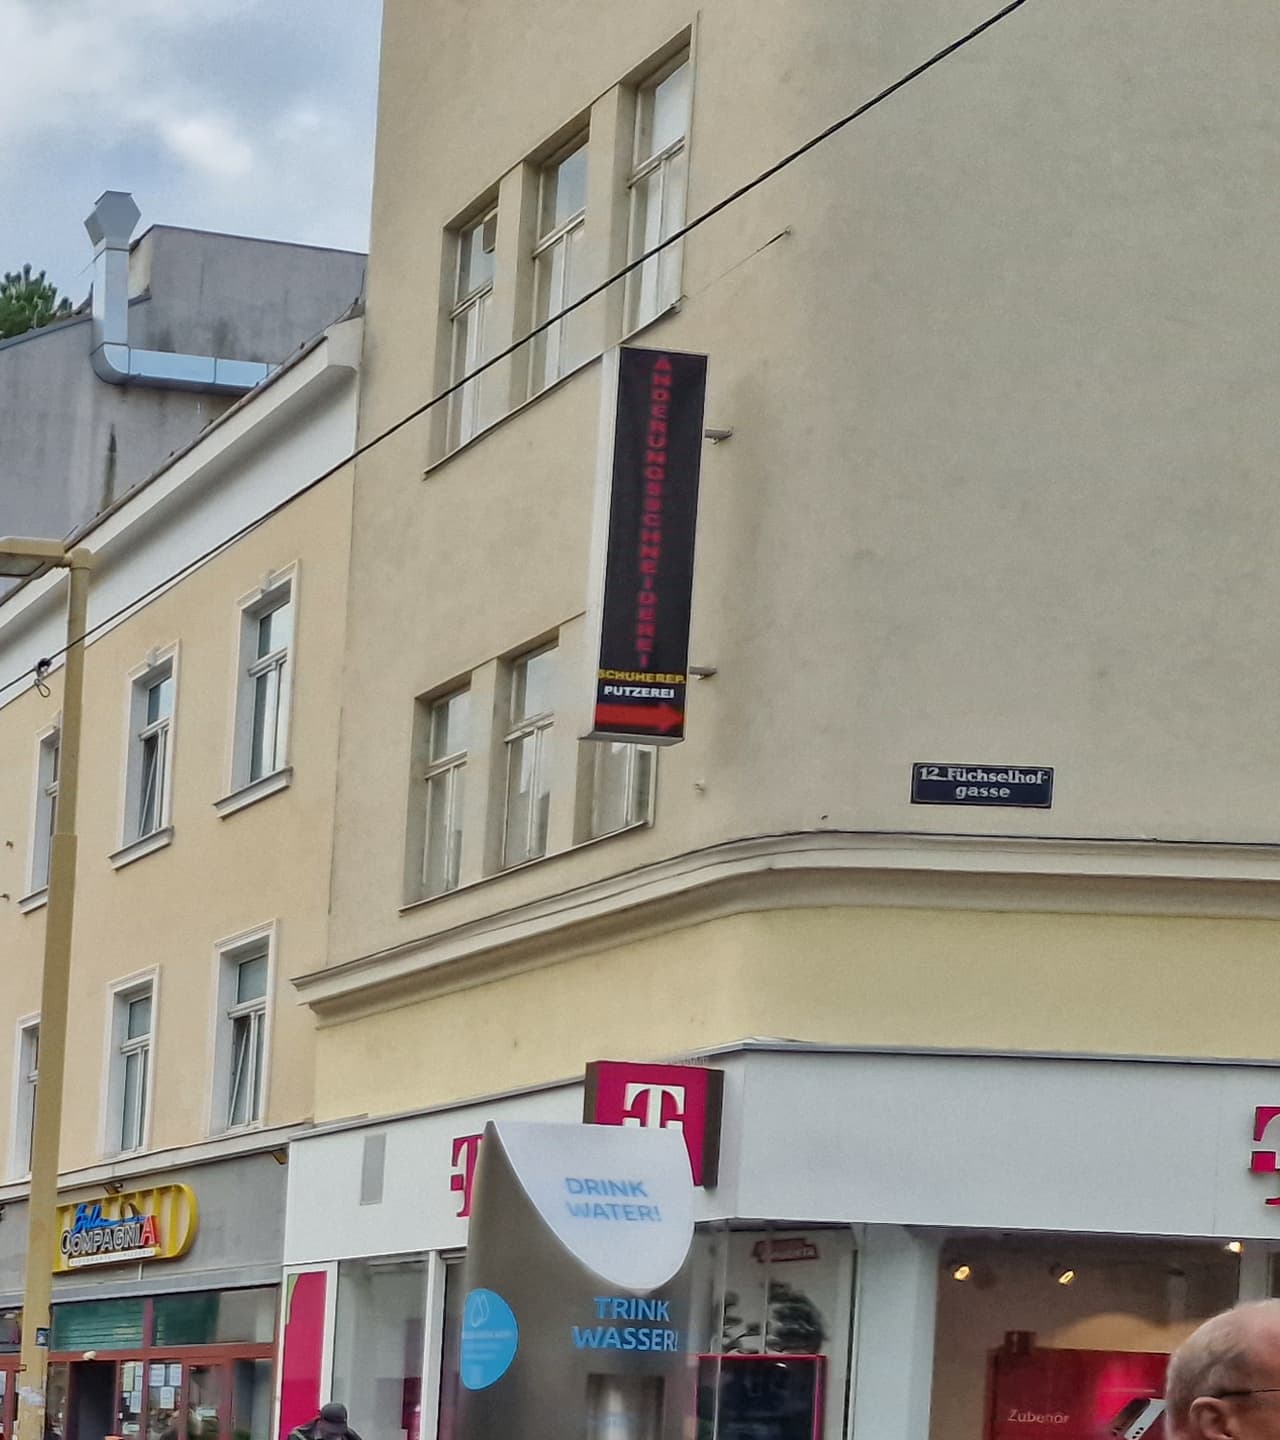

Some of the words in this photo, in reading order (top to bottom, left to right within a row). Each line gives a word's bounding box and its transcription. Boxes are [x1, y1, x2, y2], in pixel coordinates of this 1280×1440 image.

[603, 686, 675, 698] PUTZEREI
[947, 768, 1049, 784] Füchselhof-
[955, 786, 1011, 800] gasse
[565, 1177, 648, 1198] DRINK
[566, 1201, 661, 1223] WATER!
[61, 1215, 159, 1256] COMPAGNIA
[594, 1296, 670, 1321] TRINK
[572, 1325, 679, 1352] WASSER!
[1007, 1406, 1070, 1424] Zubehör
